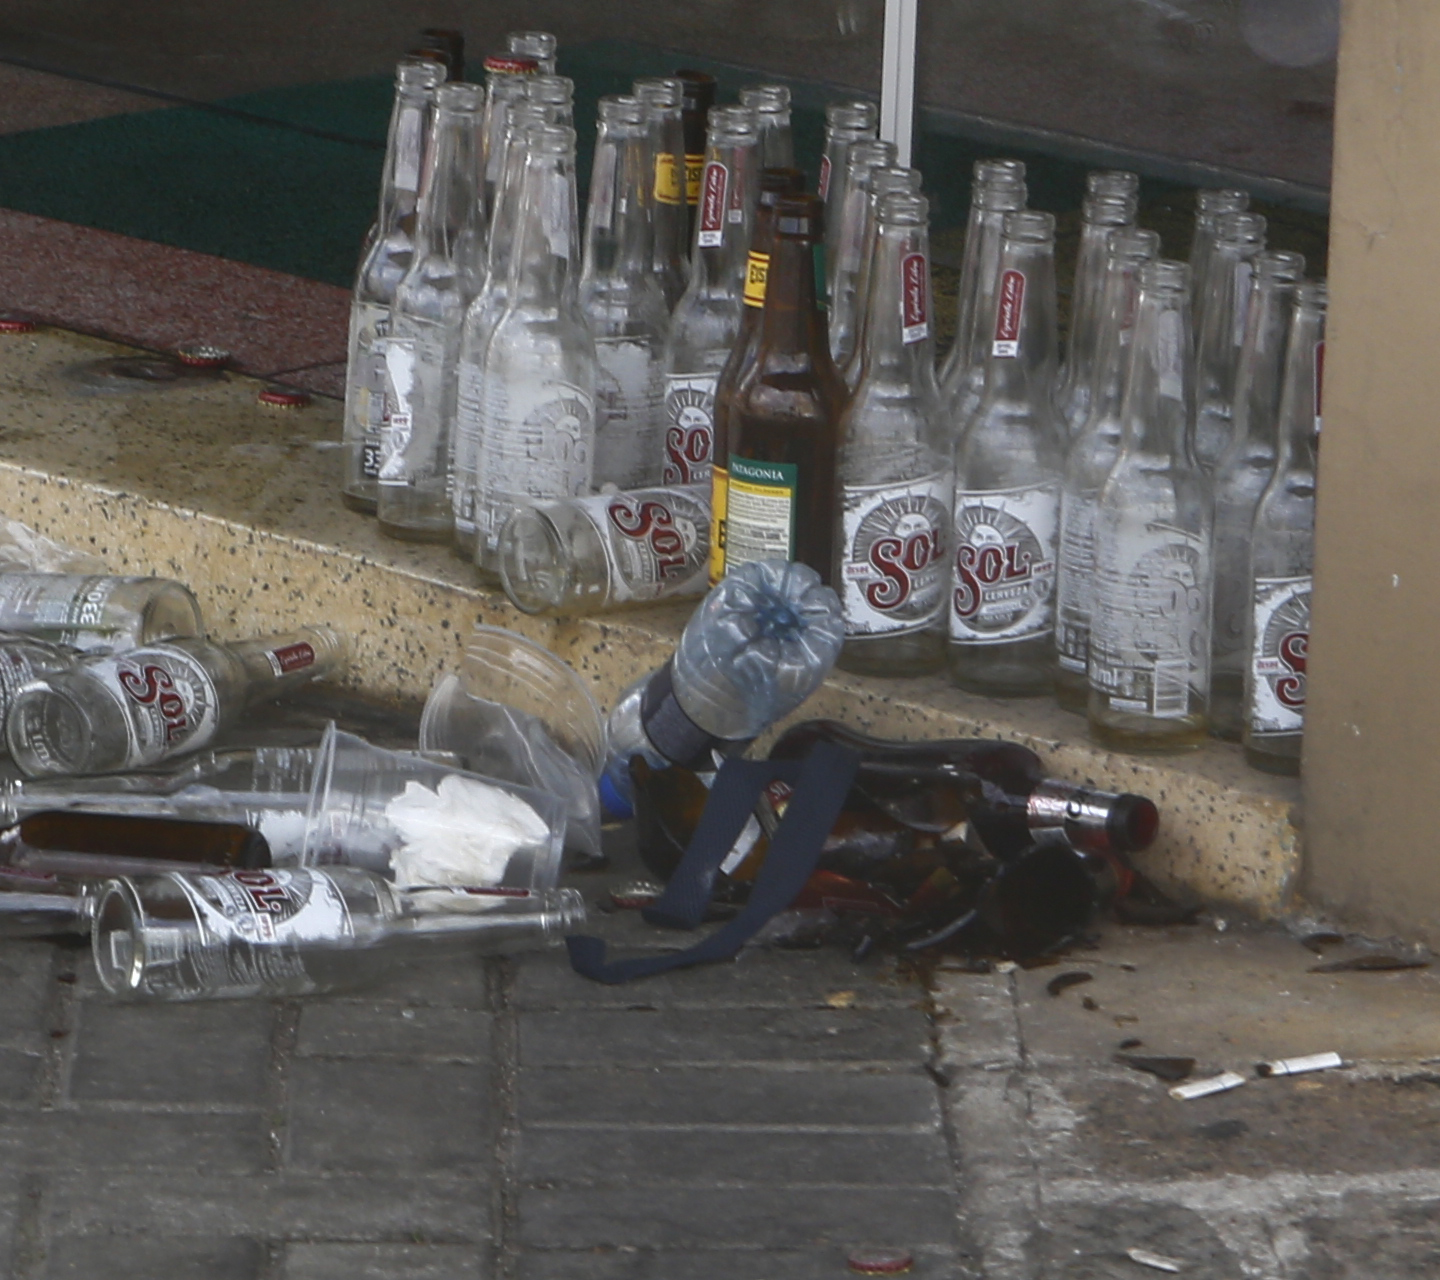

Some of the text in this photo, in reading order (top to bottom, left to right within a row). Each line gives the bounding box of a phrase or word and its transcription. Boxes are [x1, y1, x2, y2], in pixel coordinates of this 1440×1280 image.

[664, 427, 712, 484] SO
[609, 502, 686, 579] SOL
[867, 528, 945, 611] SOL
[954, 544, 1027, 617] SOL
